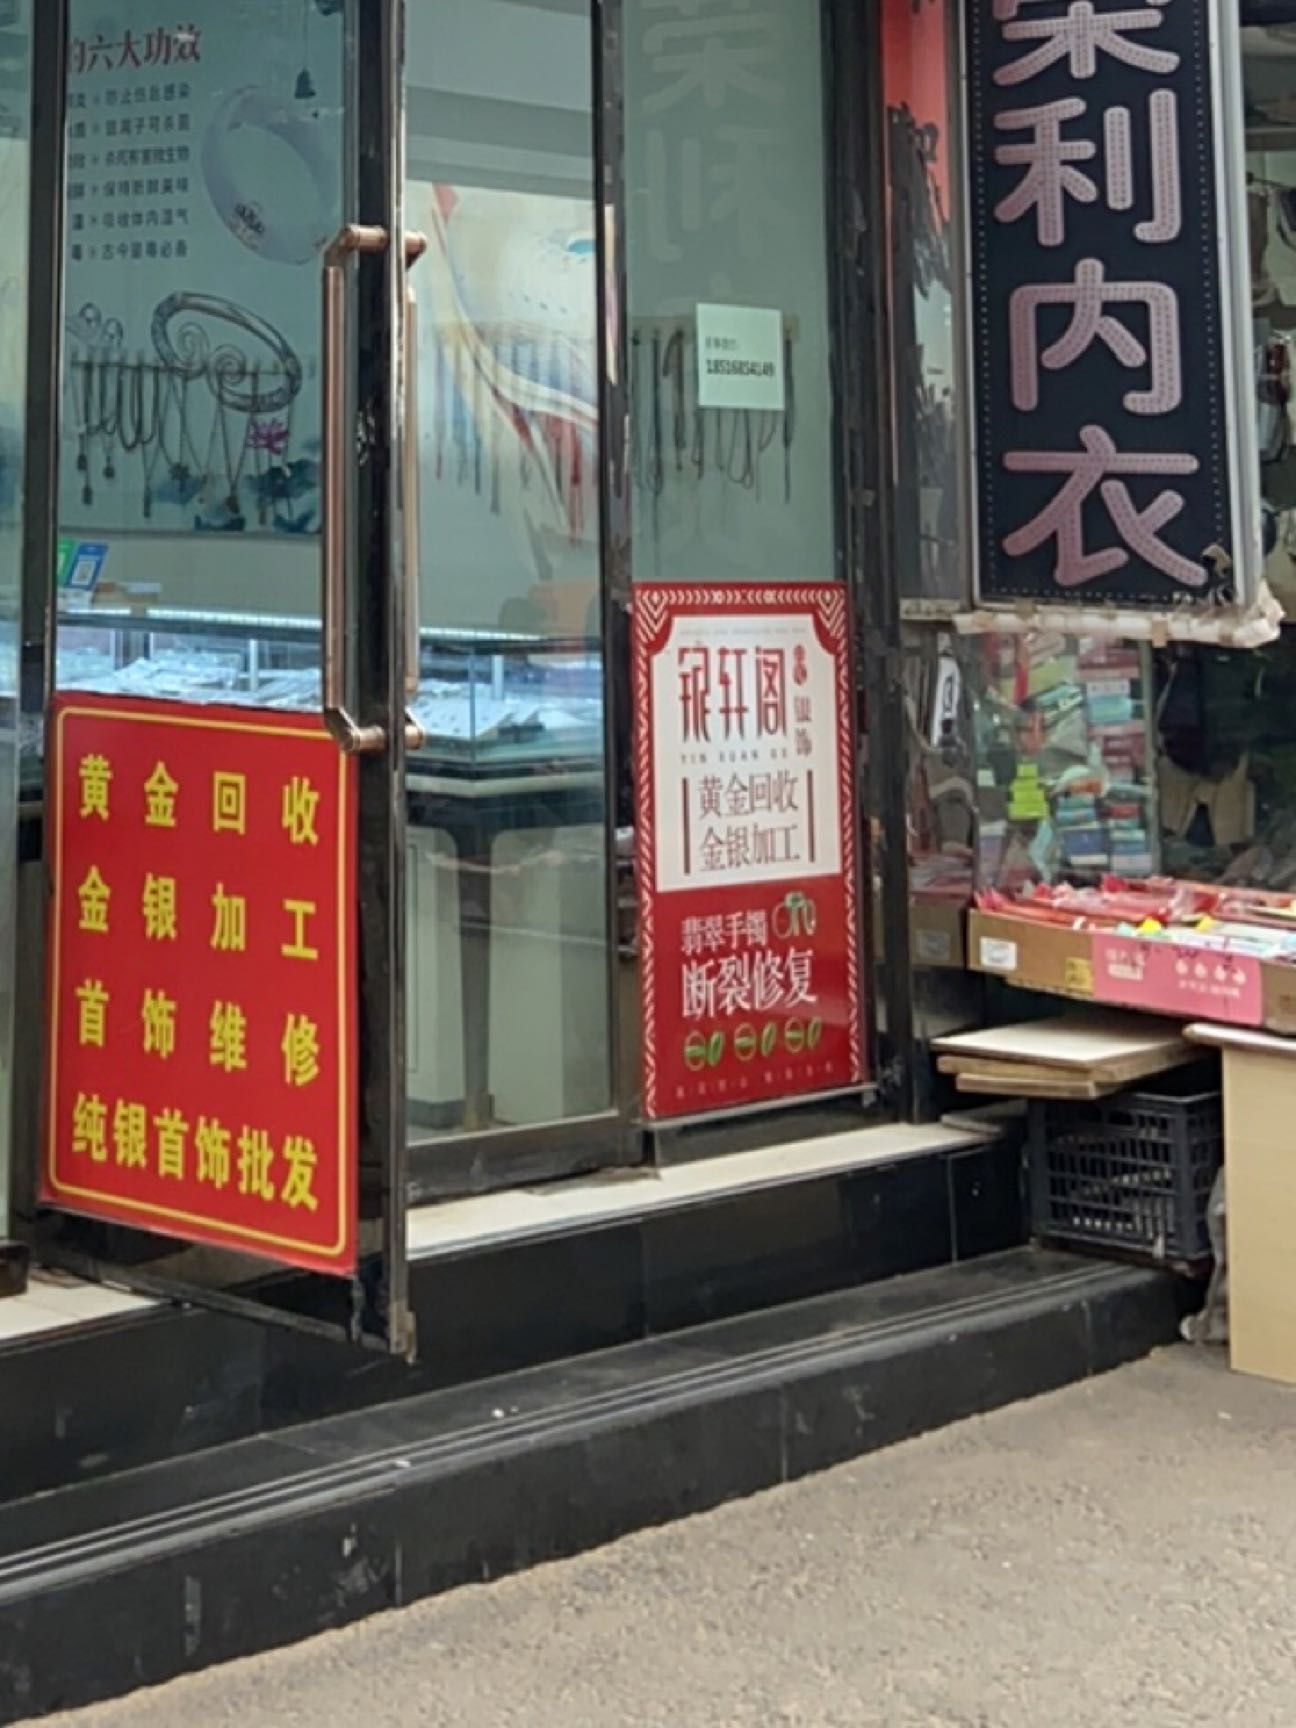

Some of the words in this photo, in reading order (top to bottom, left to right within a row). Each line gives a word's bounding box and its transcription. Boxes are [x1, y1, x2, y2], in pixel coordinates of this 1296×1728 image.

[677, 645, 787, 745] 银轩阁
[77, 752, 320, 846] 黄金回收
[698, 771, 800, 821] 黄金回收
[698, 822, 801, 873] 金银加工
[76, 865, 319, 961] 金银加工
[681, 946, 818, 1020] 断裂修复
[75, 978, 320, 1087] 首饰维修
[71, 1092, 319, 1211] 纯银首饰批发
